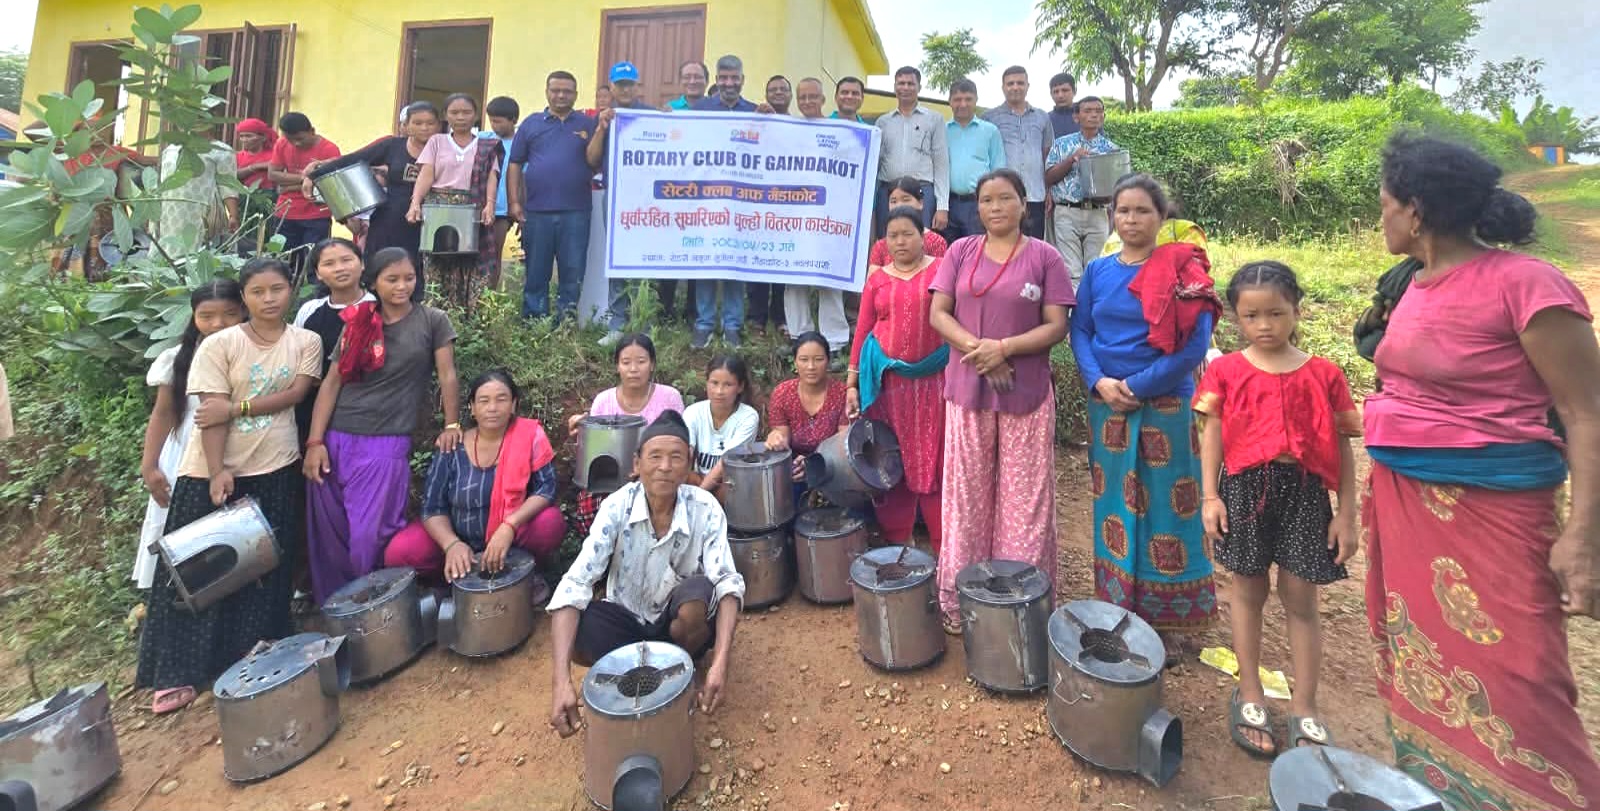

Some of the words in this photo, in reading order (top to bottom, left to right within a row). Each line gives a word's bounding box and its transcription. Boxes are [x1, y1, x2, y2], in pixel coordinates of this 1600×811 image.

[642, 130, 667, 139] Rotary
[622, 149, 689, 168] ROTARY
[693, 150, 737, 167] CLUB
[741, 153, 762, 171] OF
[765, 154, 860, 180] GAINDAKOT
[661, 180, 698, 198] रोटरी
[702, 184, 733, 197] क्लब
[736, 187, 765, 201] अफ
[764, 211, 803, 232] वितरण
[804, 215, 853, 239] कार्यक्रम
